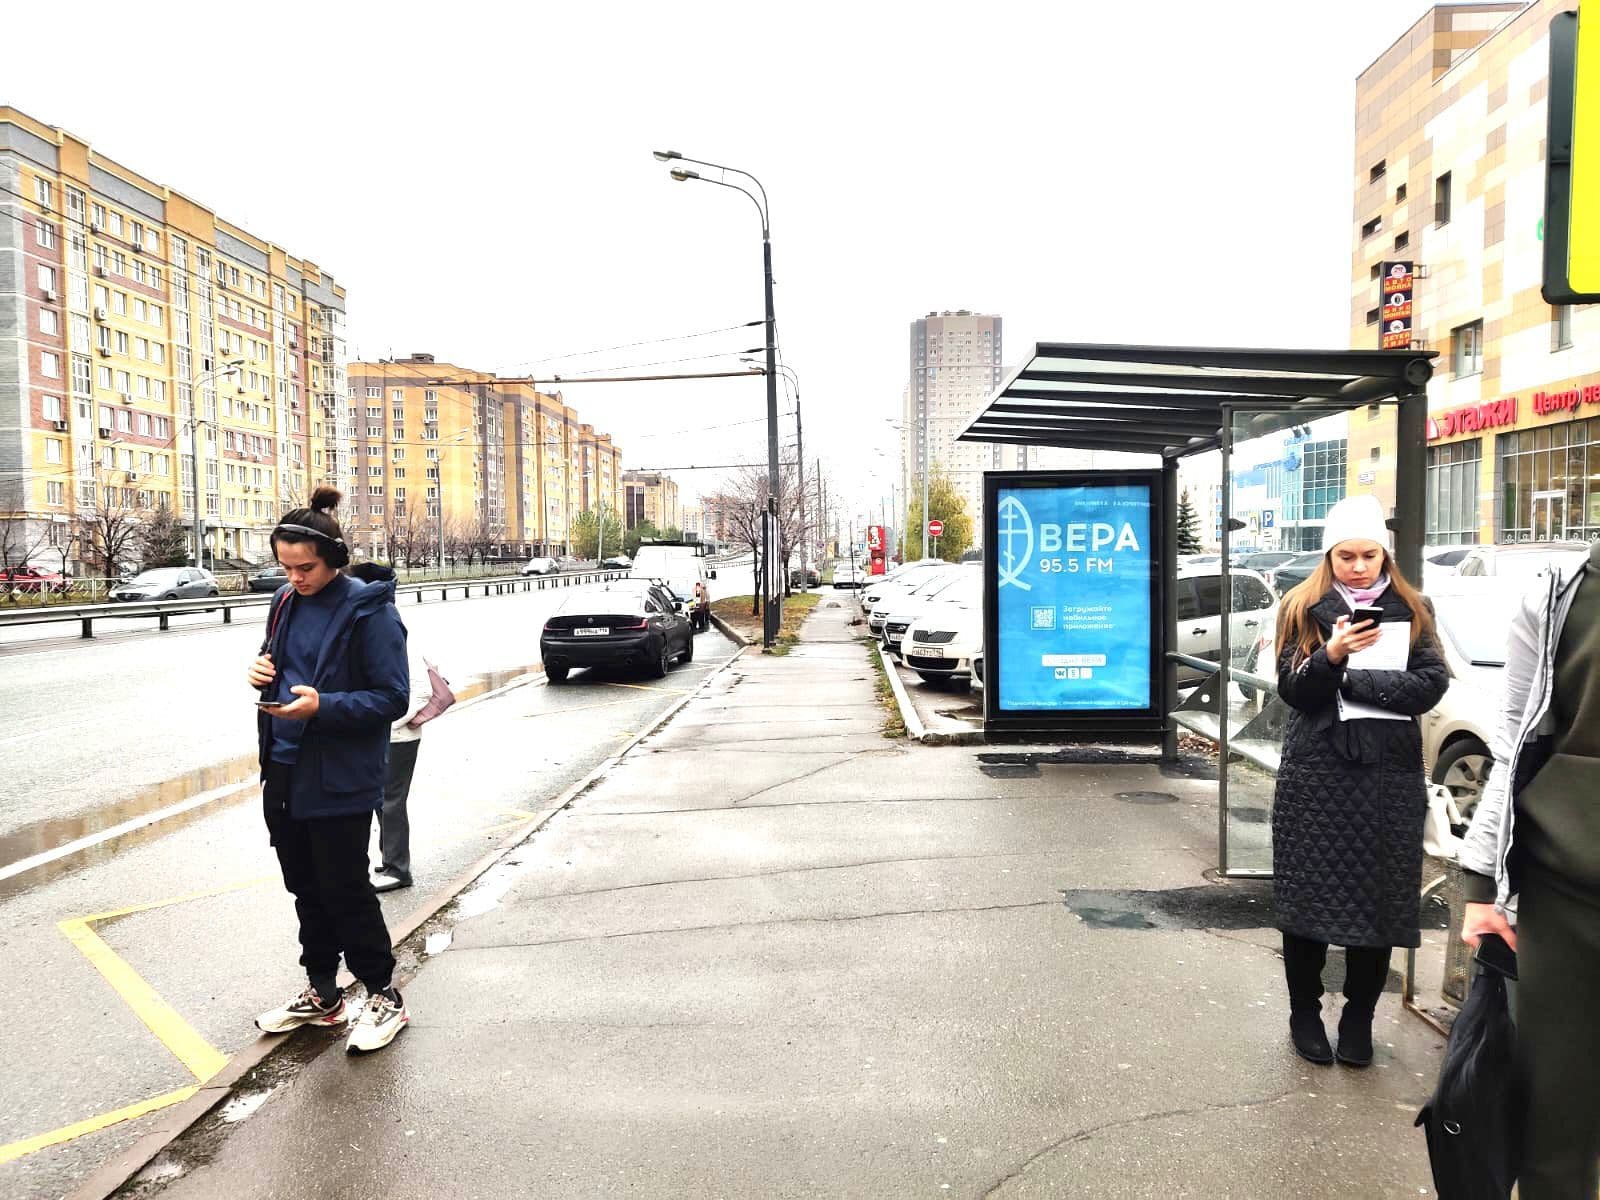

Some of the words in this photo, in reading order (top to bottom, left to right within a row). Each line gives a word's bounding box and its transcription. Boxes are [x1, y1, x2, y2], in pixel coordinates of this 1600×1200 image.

[1533, 390, 1579, 416] Центр
[1039, 522, 1140, 552] ВЕРА
[1039, 558, 1079, 573] 95.5
[1086, 558, 1113, 573] FM
[1063, 605, 1112, 614] Загружайте
